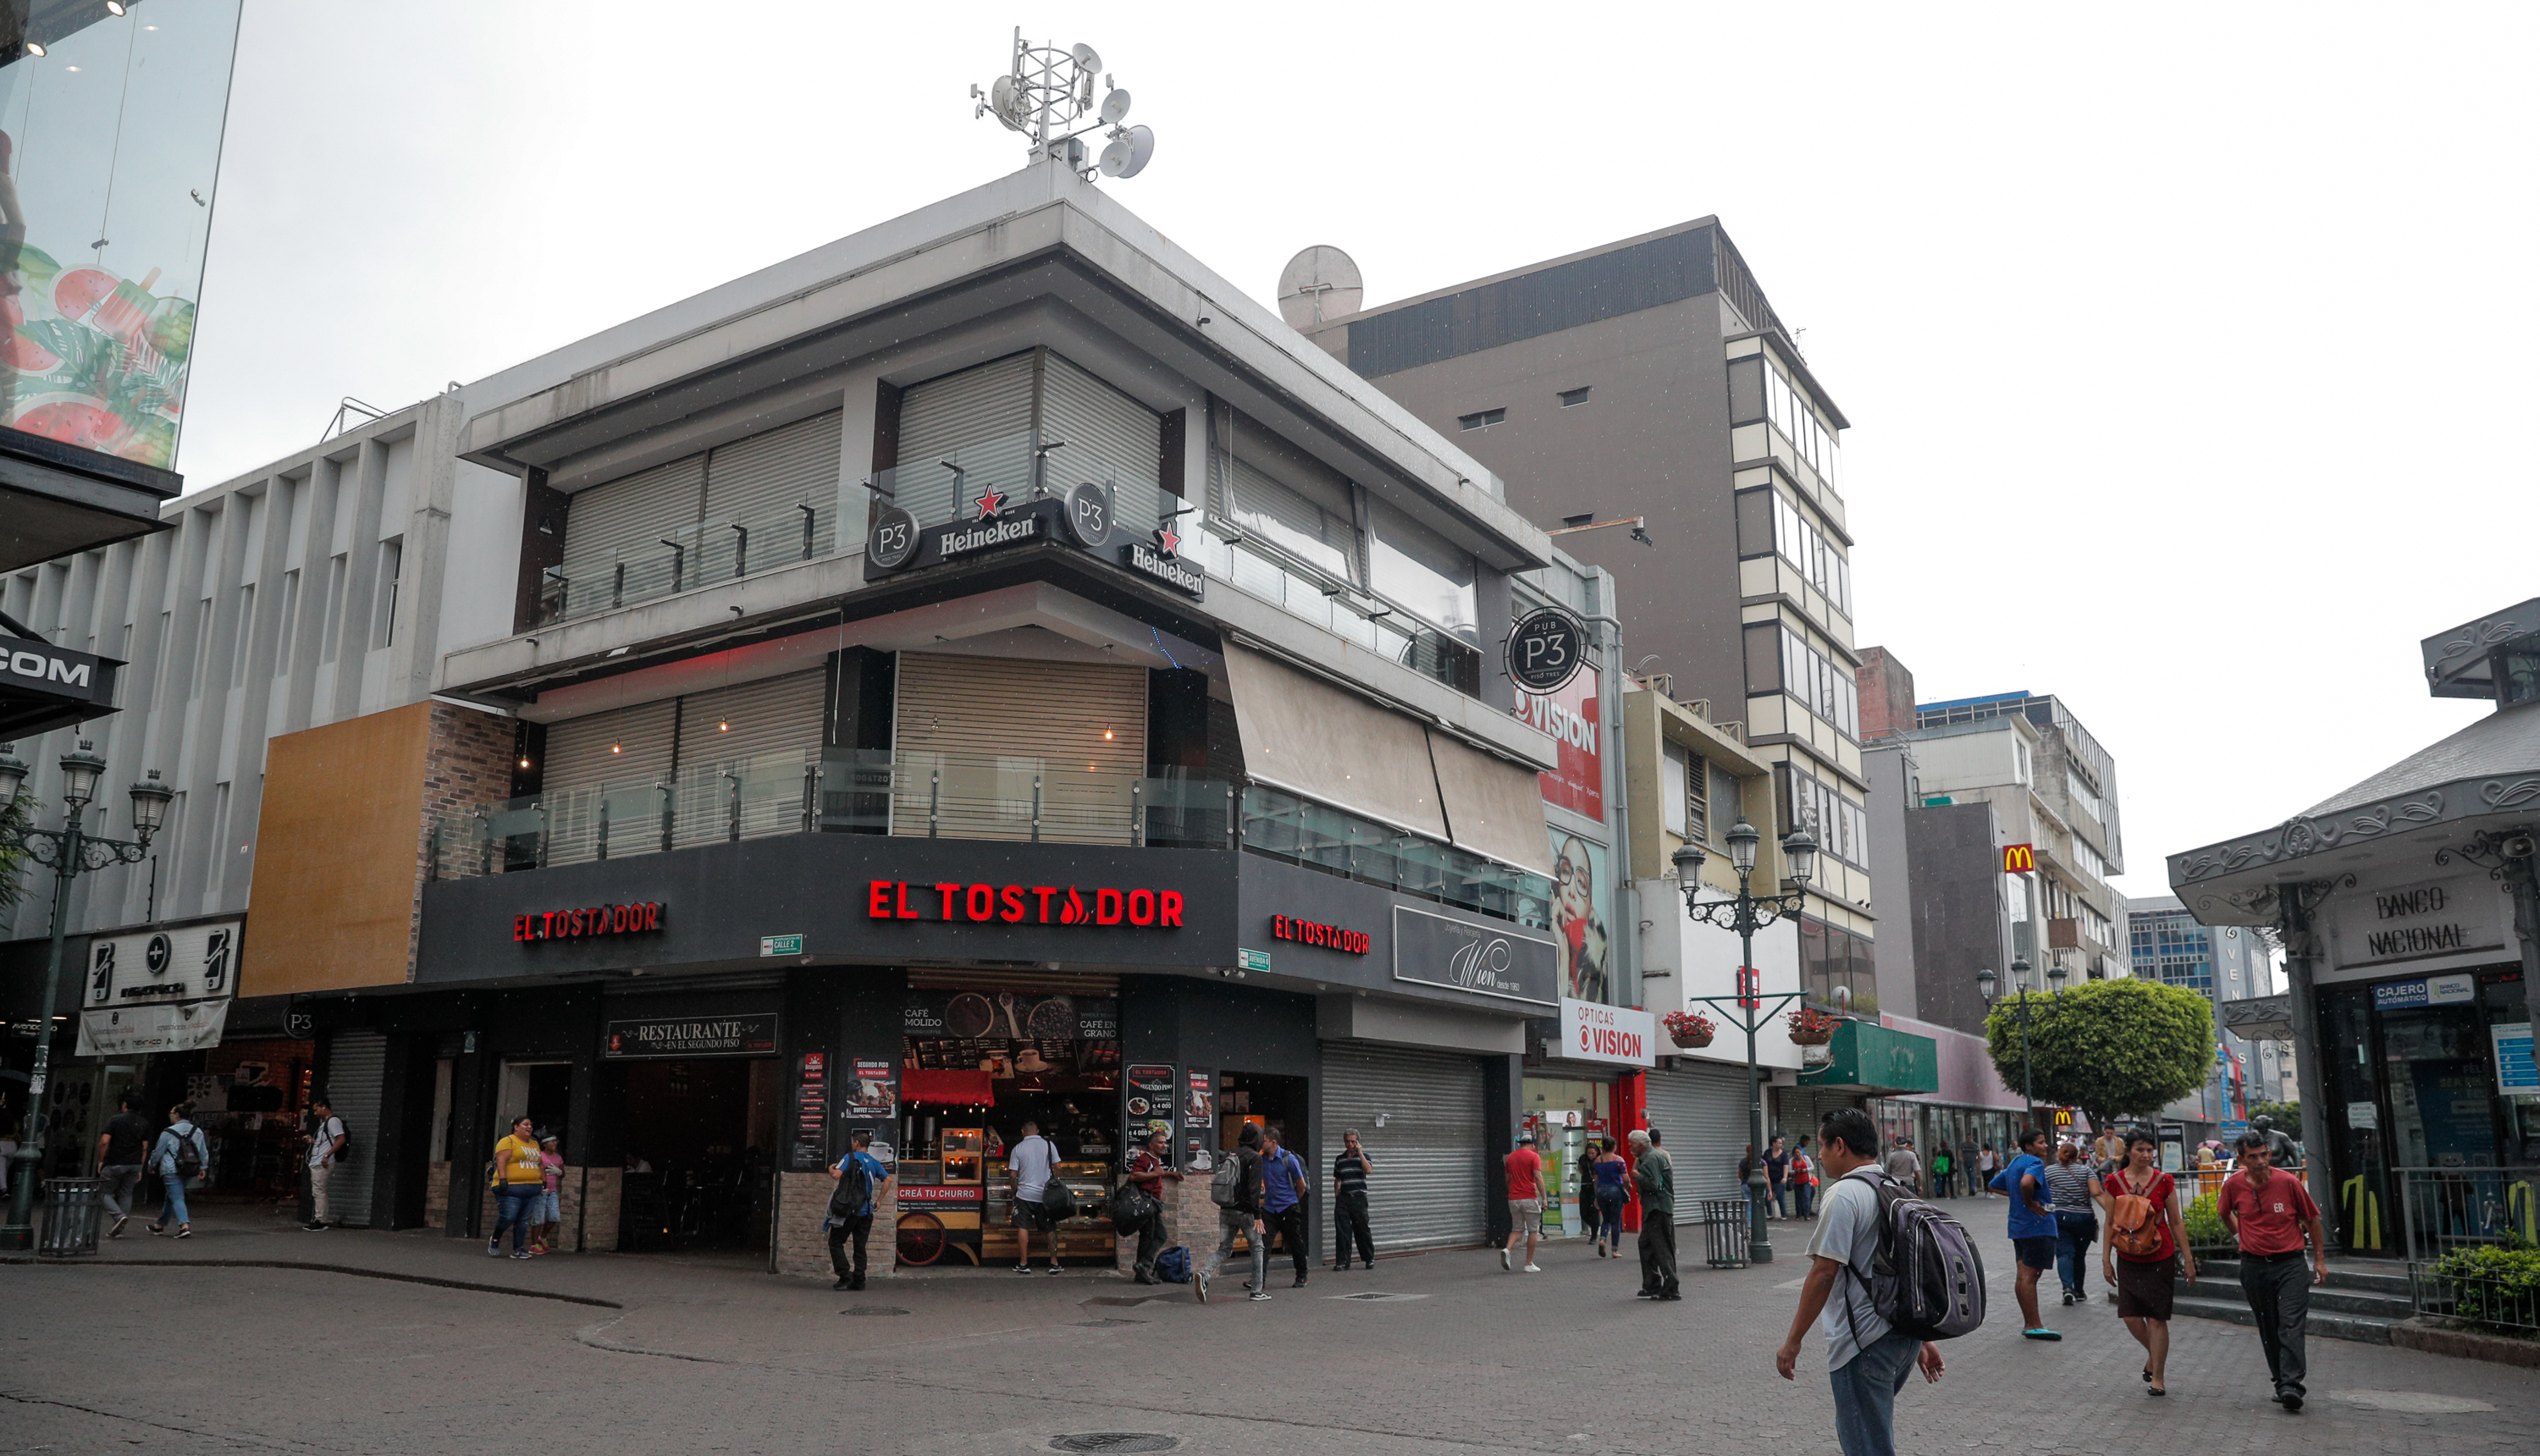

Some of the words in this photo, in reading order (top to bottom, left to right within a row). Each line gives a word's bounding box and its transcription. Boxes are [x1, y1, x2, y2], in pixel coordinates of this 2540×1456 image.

[1078, 498, 1102, 532] P3
[880, 523, 906, 554] P3
[940, 518, 1035, 555] Heineken
[1132, 543, 1203, 593] Heineken
[1534, 621, 1556, 631] PUB
[1525, 633, 1565, 669] P3
[1532, 694, 1596, 756] VISION
[869, 880, 919, 918] EL
[2376, 887, 2444, 919] BANCO
[513, 914, 535, 941] EL
[1275, 914, 1293, 940] EL
[774, 940, 790, 949] CALLE
[790, 940, 795, 948] 2
[2367, 924, 2471, 957] NACIONAL
[1449, 938, 1512, 988] Wien
[1496, 979, 1510, 990] desde
[2377, 983, 2426, 997] CAJERO
[290, 1014, 312, 1029] P3
[904, 1018, 942, 1027] MOLIDO
[1080, 1019, 1103, 1029] CAFÉ
[1578, 1007, 1615, 1025] OPTICAS
[639, 1021, 741, 1041] RESTAURANTE
[1593, 1027, 1642, 1058] VISION
[677, 1041, 687, 1050] EL
[687, 1040, 722, 1049] SEGUNDO
[723, 1039, 740, 1048] PISO
[899, 1189, 922, 1198] CREÁ
[925, 1189, 936, 1198] TU
[939, 1189, 975, 1198] CHURRO
[2273, 1202, 2284, 1213] ER
